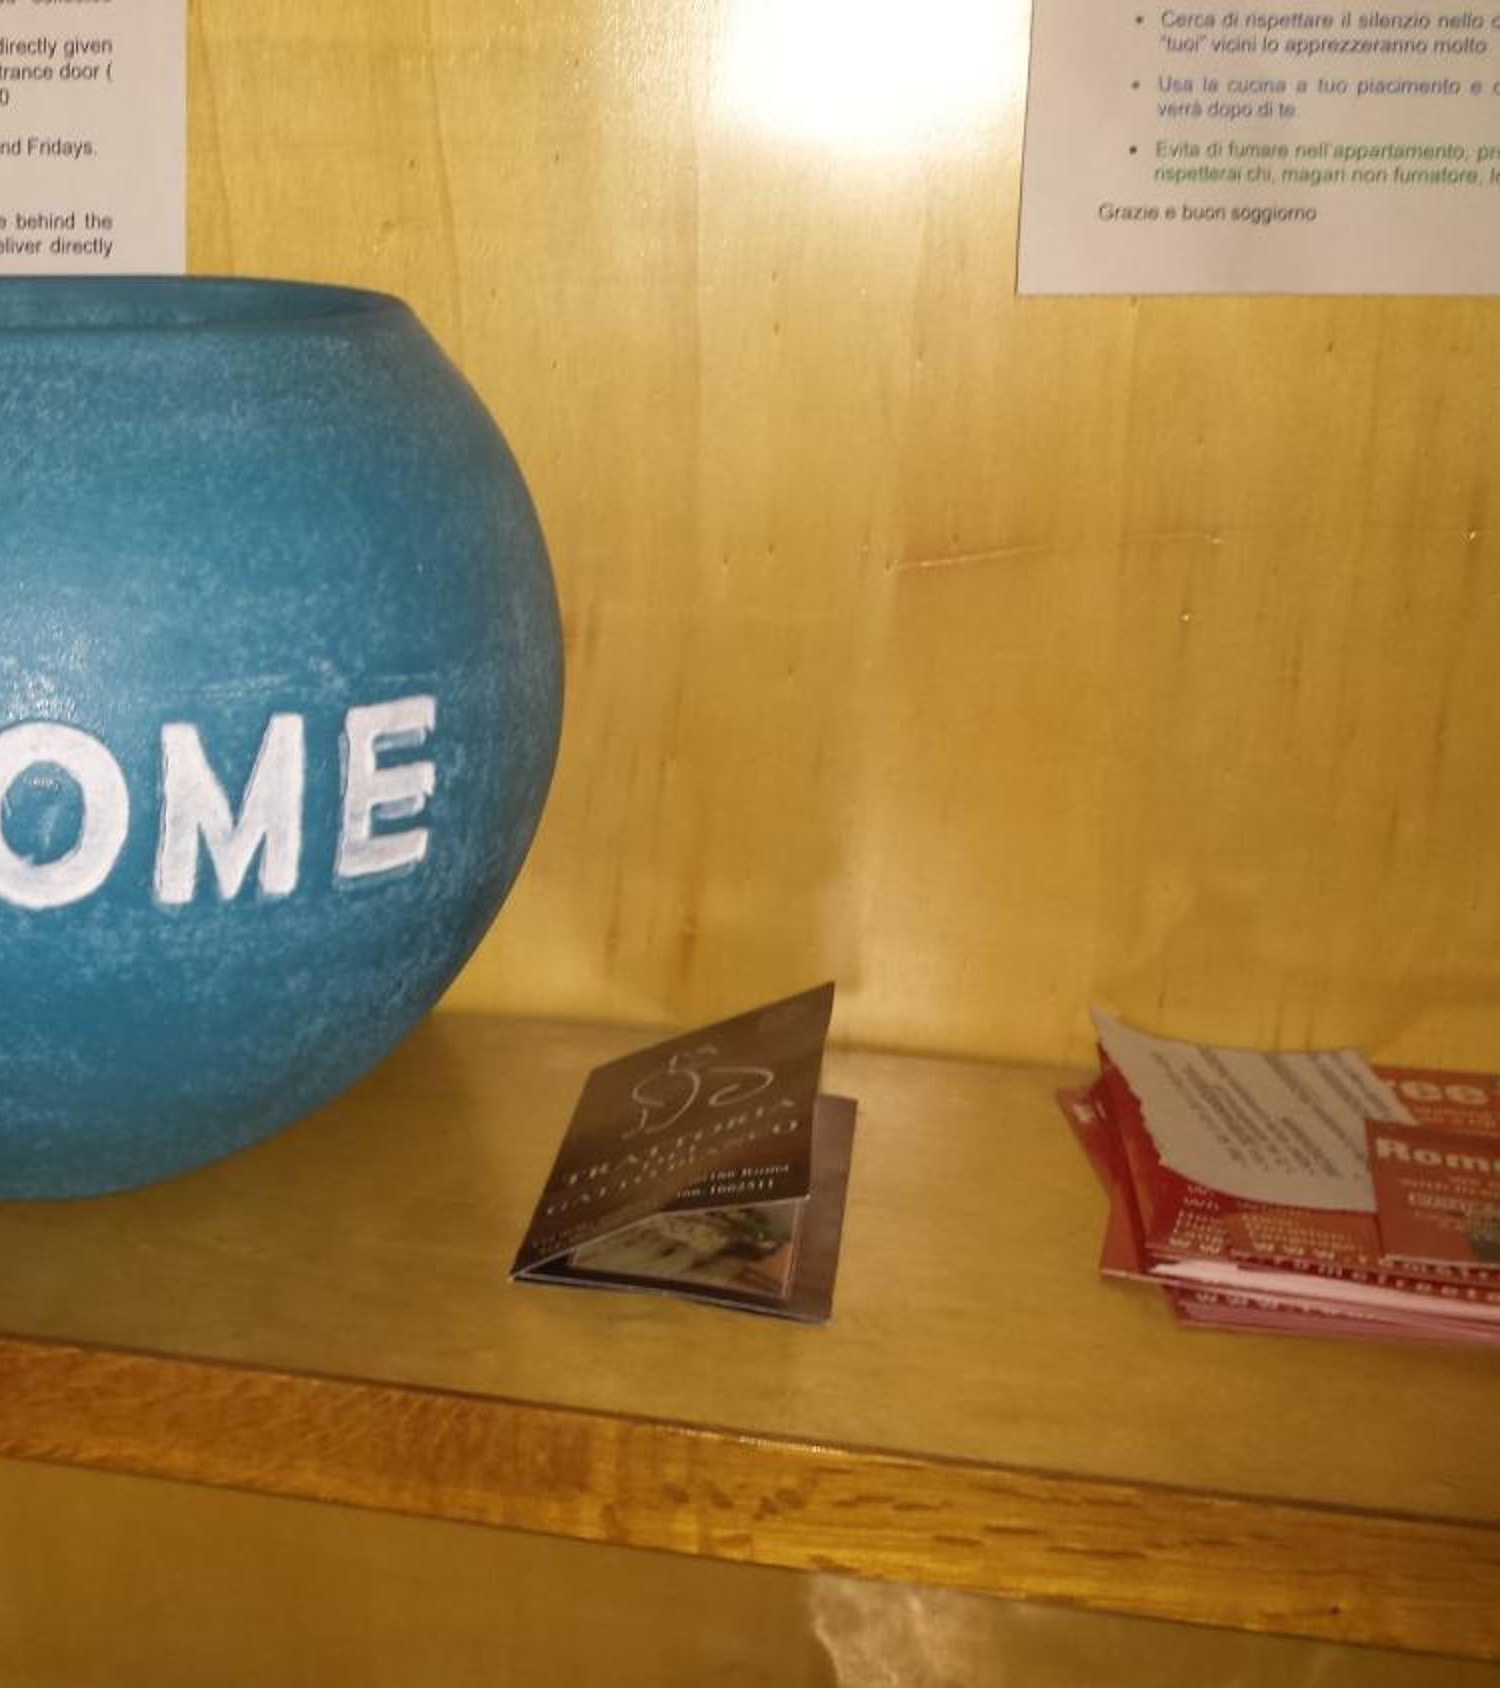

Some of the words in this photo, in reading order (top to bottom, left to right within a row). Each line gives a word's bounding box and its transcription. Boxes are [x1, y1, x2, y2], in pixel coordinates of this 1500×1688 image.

[1161, 11, 1215, 28] Cerca
[1222, 13, 1238, 28] di
[1245, 12, 1333, 31] rispettare
[1341, 12, 1350, 28] il
[1358, 12, 1431, 29] silenzio
[1438, 13, 1484, 29] nello
[63, 39, 113, 58] given
[1211, 38, 1256, 53] vicini
[1263, 37, 1279, 52] lo
[1285, 38, 1428, 57] apprezzeranno
[59, 62, 100, 80] door
[1159, 76, 1193, 93] Usa
[1202, 77, 1218, 92] la
[1227, 79, 1286, 93] cucina
[1296, 80, 1307, 92] a
[1318, 79, 1347, 94] tuo
[1357, 79, 1461, 96] piacimento
[1471, 80, 1482, 94] e
[1207, 102, 1252, 120] dopo
[1258, 102, 1273, 117] di
[1155, 141, 1200, 158] Evita
[1206, 143, 1223, 158] di
[1228, 141, 1289, 158] fumare
[1154, 167, 1242, 184] rispetterai
[1282, 168, 1346, 186] magari
[1351, 170, 1387, 183] non
[15, 212, 76, 230] behind
[1099, 203, 1160, 220] Grazie
[1165, 207, 1176, 220] e
[1182, 204, 1226, 220] buon
[1231, 207, 1316, 224] soggiorno
[49, 236, 113, 258] directly
